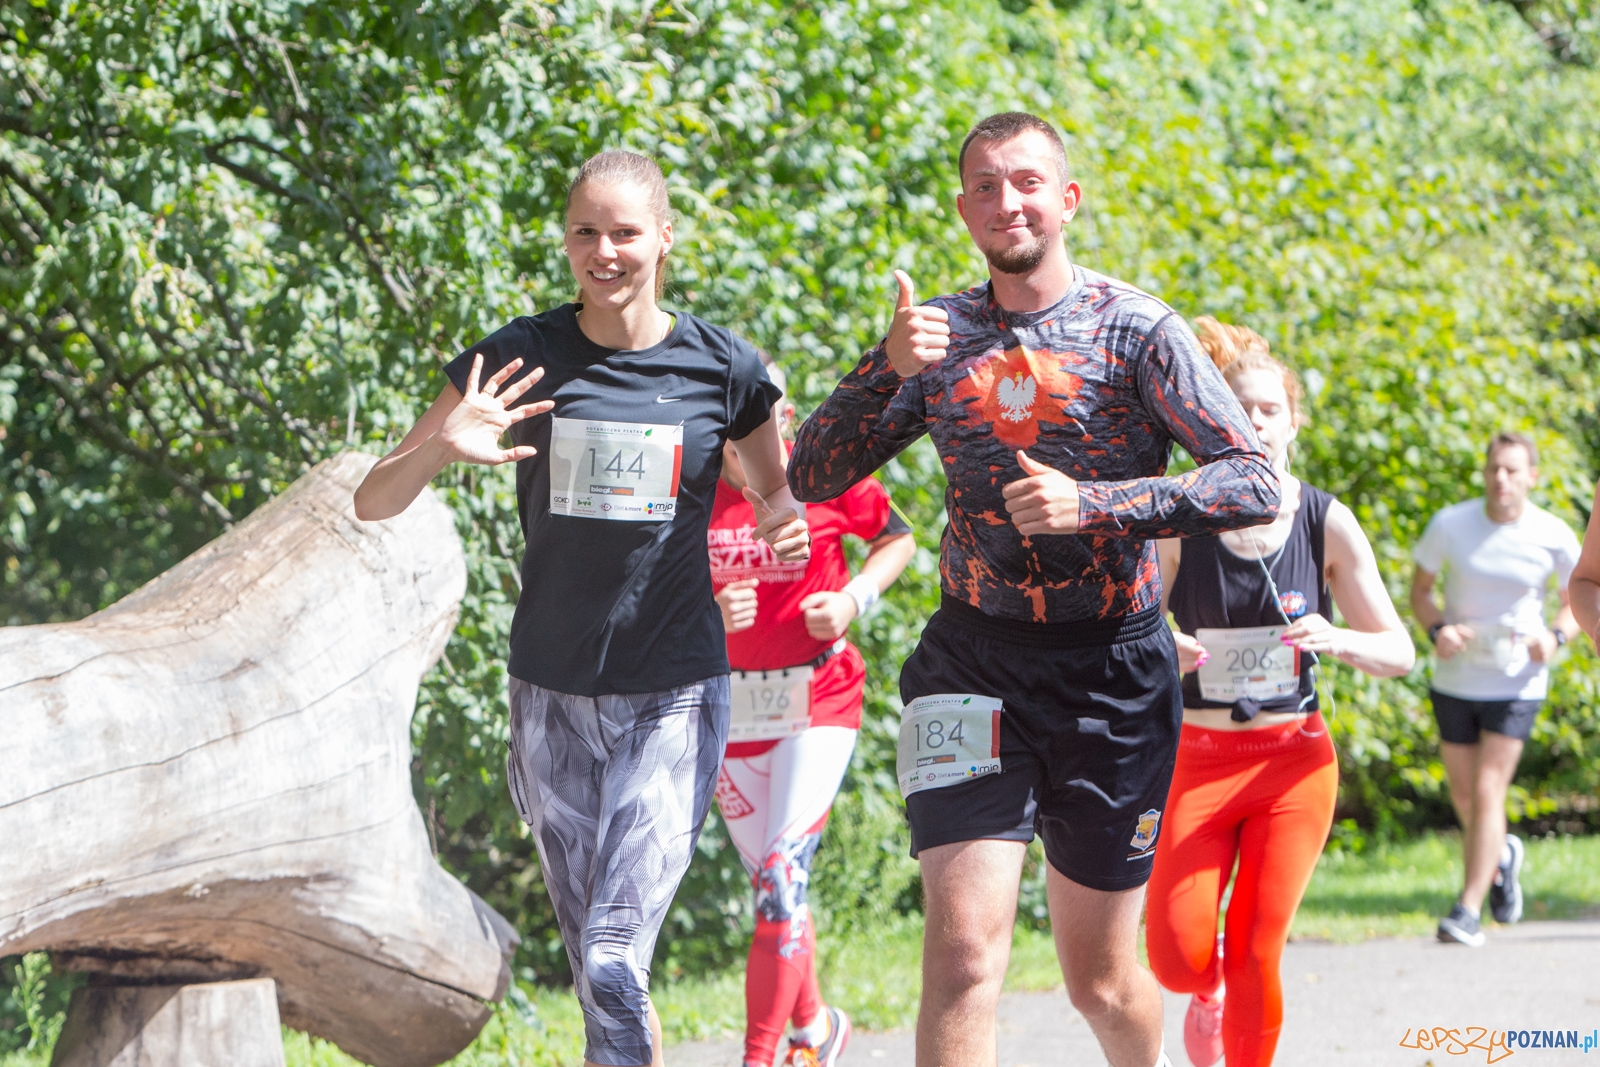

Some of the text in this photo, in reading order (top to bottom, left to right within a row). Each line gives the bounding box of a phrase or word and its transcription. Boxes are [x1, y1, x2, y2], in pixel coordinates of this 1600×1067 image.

[588, 447, 645, 480] 144
[1225, 646, 1273, 672] 206
[748, 686, 791, 712] 196
[914, 718, 965, 752] 184
